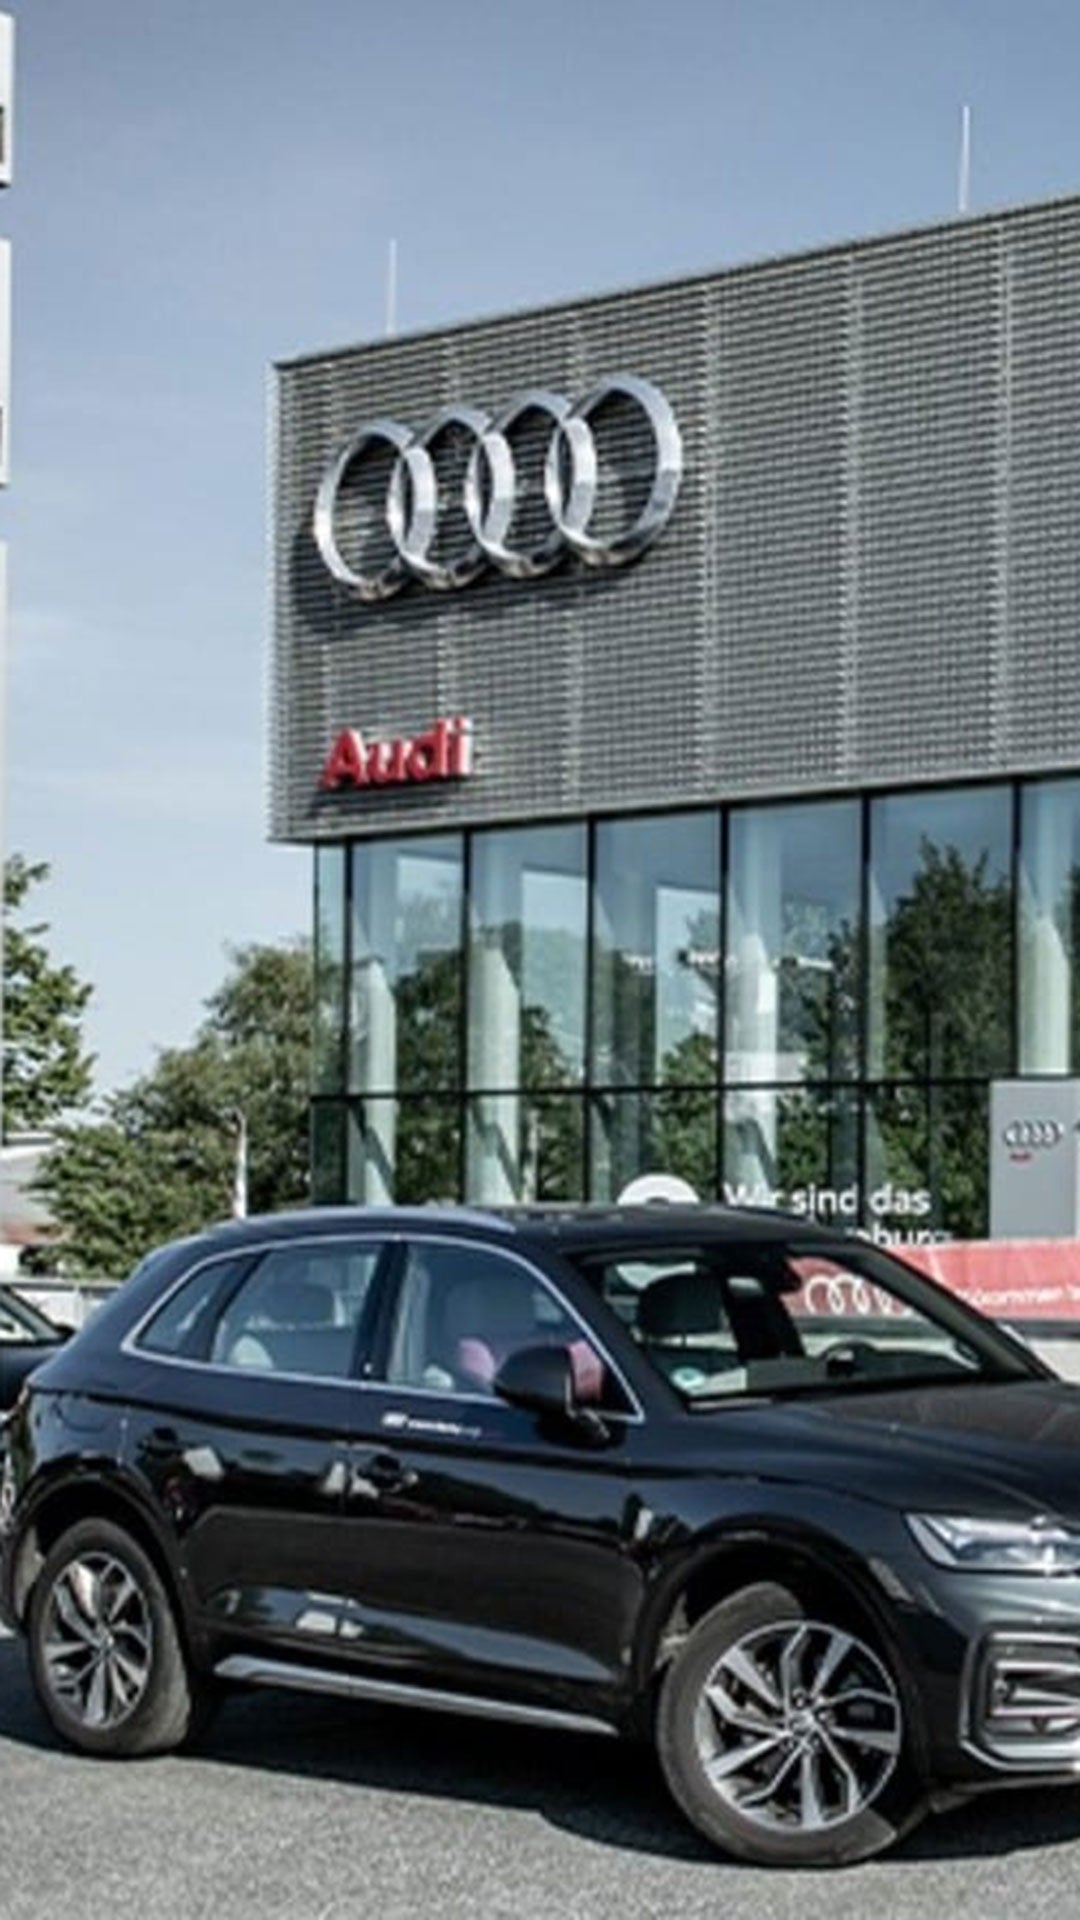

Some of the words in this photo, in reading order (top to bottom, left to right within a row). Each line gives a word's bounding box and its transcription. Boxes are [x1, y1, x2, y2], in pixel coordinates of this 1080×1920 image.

[319, 717, 473, 790] Audi
[723, 1183, 784, 1207] Wir
[791, 1183, 858, 1214] sind
[869, 1183, 931, 1215] das
